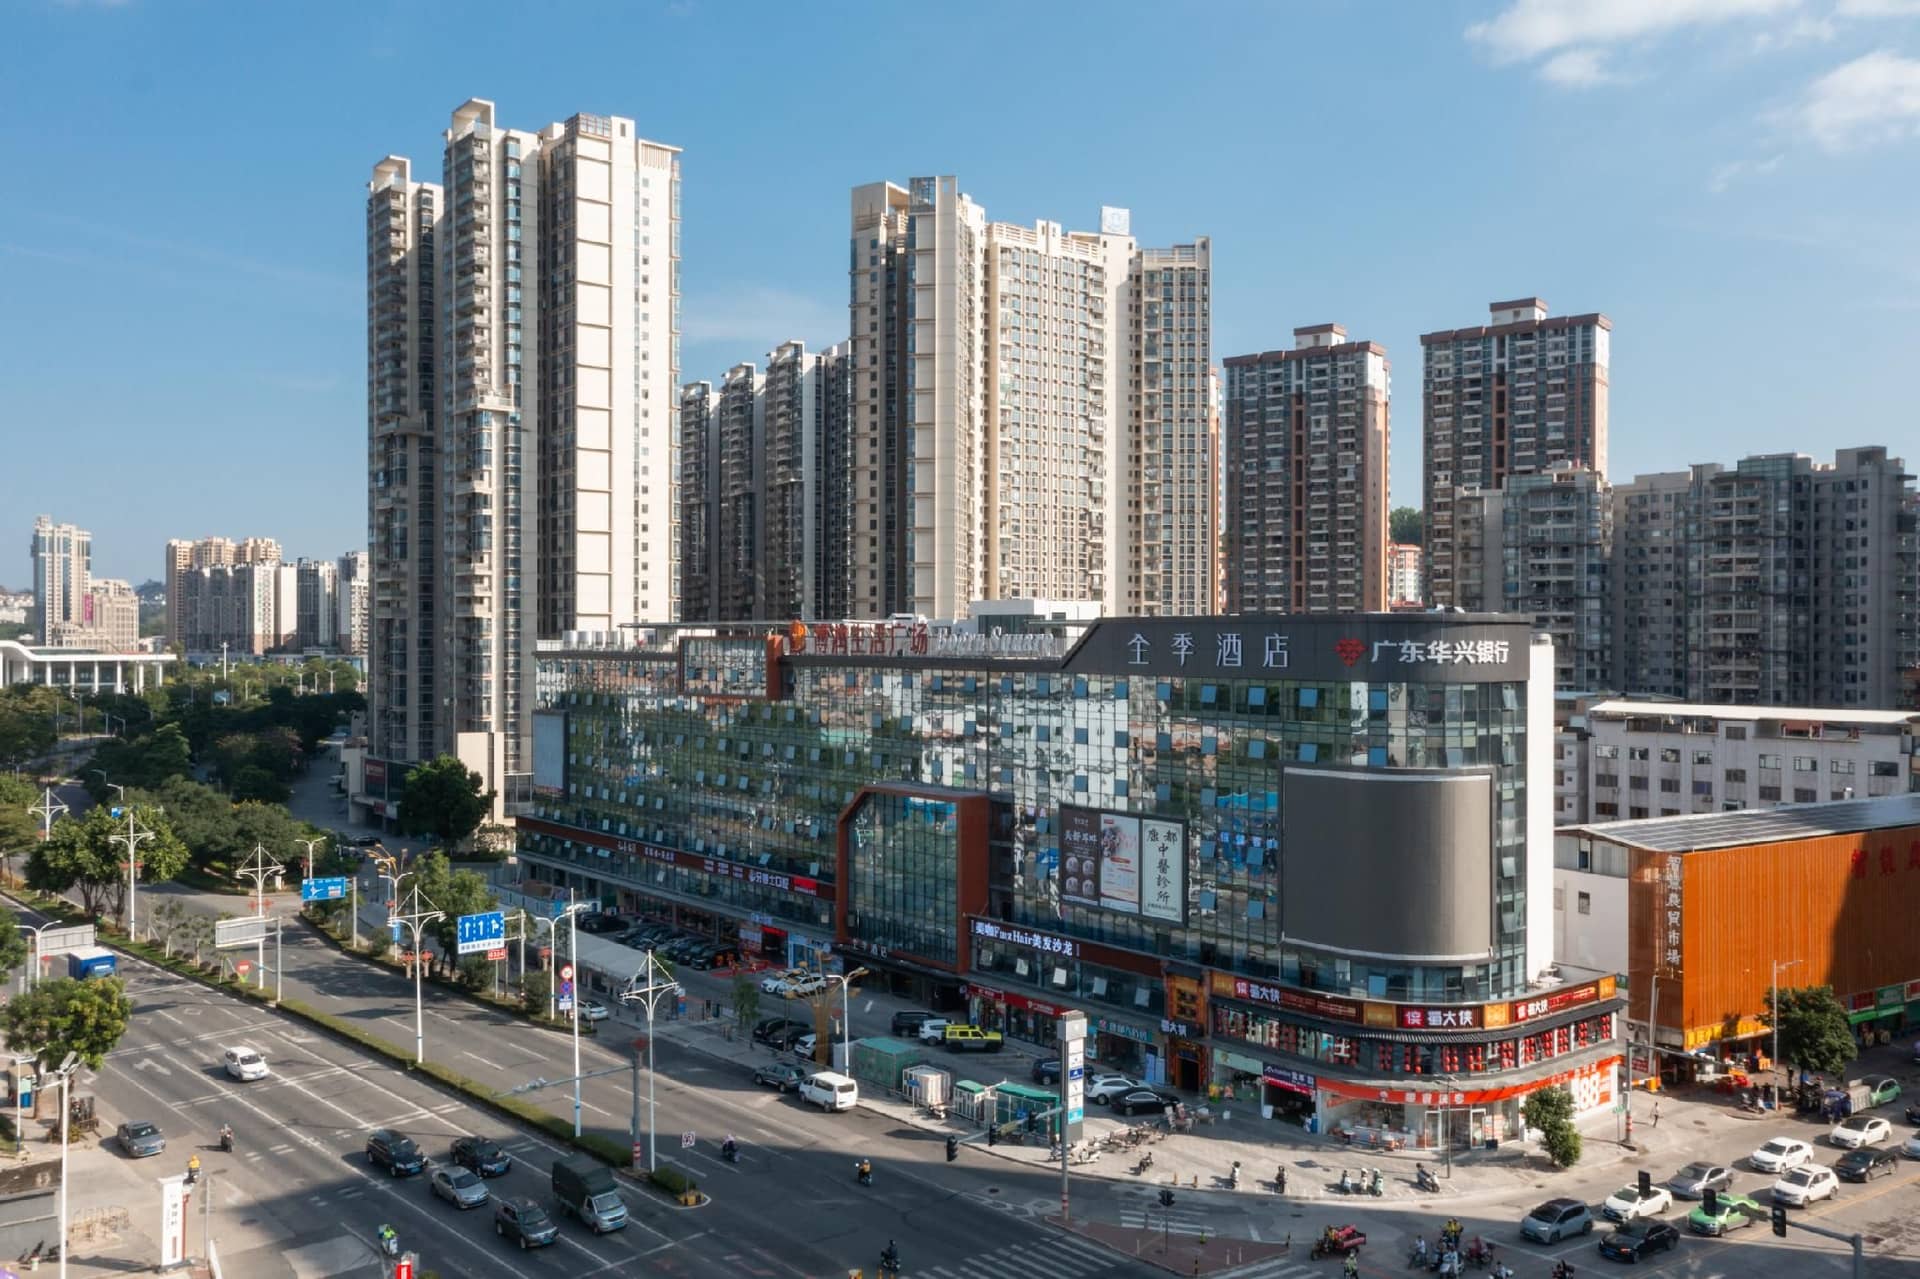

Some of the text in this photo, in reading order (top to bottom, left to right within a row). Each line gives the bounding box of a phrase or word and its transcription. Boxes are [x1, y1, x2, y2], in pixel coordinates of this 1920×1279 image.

[1128, 633, 1289, 667] 全季酒店
[1371, 640, 1510, 664] 广东华兴银行
